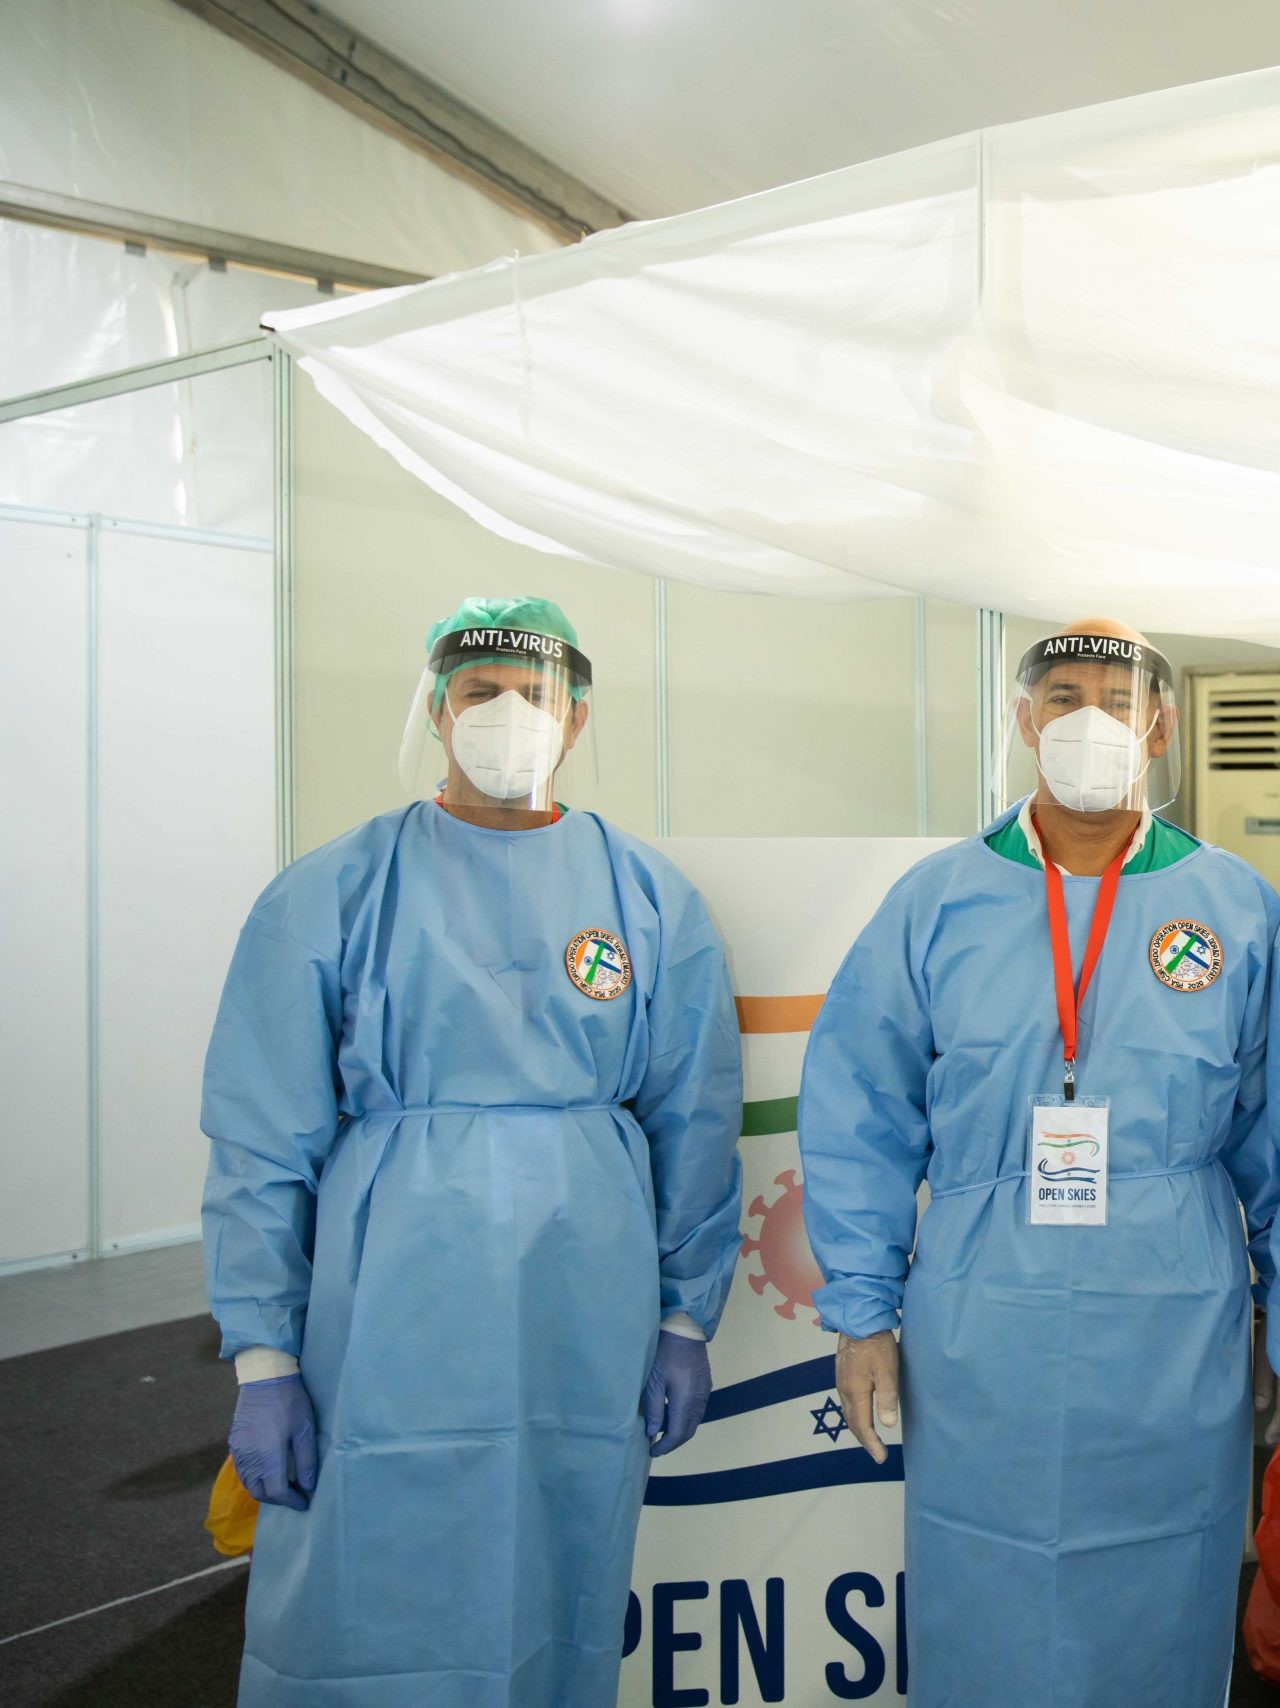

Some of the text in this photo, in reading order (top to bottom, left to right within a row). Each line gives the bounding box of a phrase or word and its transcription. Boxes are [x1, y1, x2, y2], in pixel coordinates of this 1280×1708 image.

[460, 630, 563, 658] ANTI-VIRUS
[1044, 637, 1143, 661] ANTI-VIRUS
[1154, 924, 1177, 948] OPERATION
[1193, 926, 1209, 939] SKIES
[569, 934, 586, 963] OPERATION
[1038, 1188, 1096, 1201] OPEN SKIES
